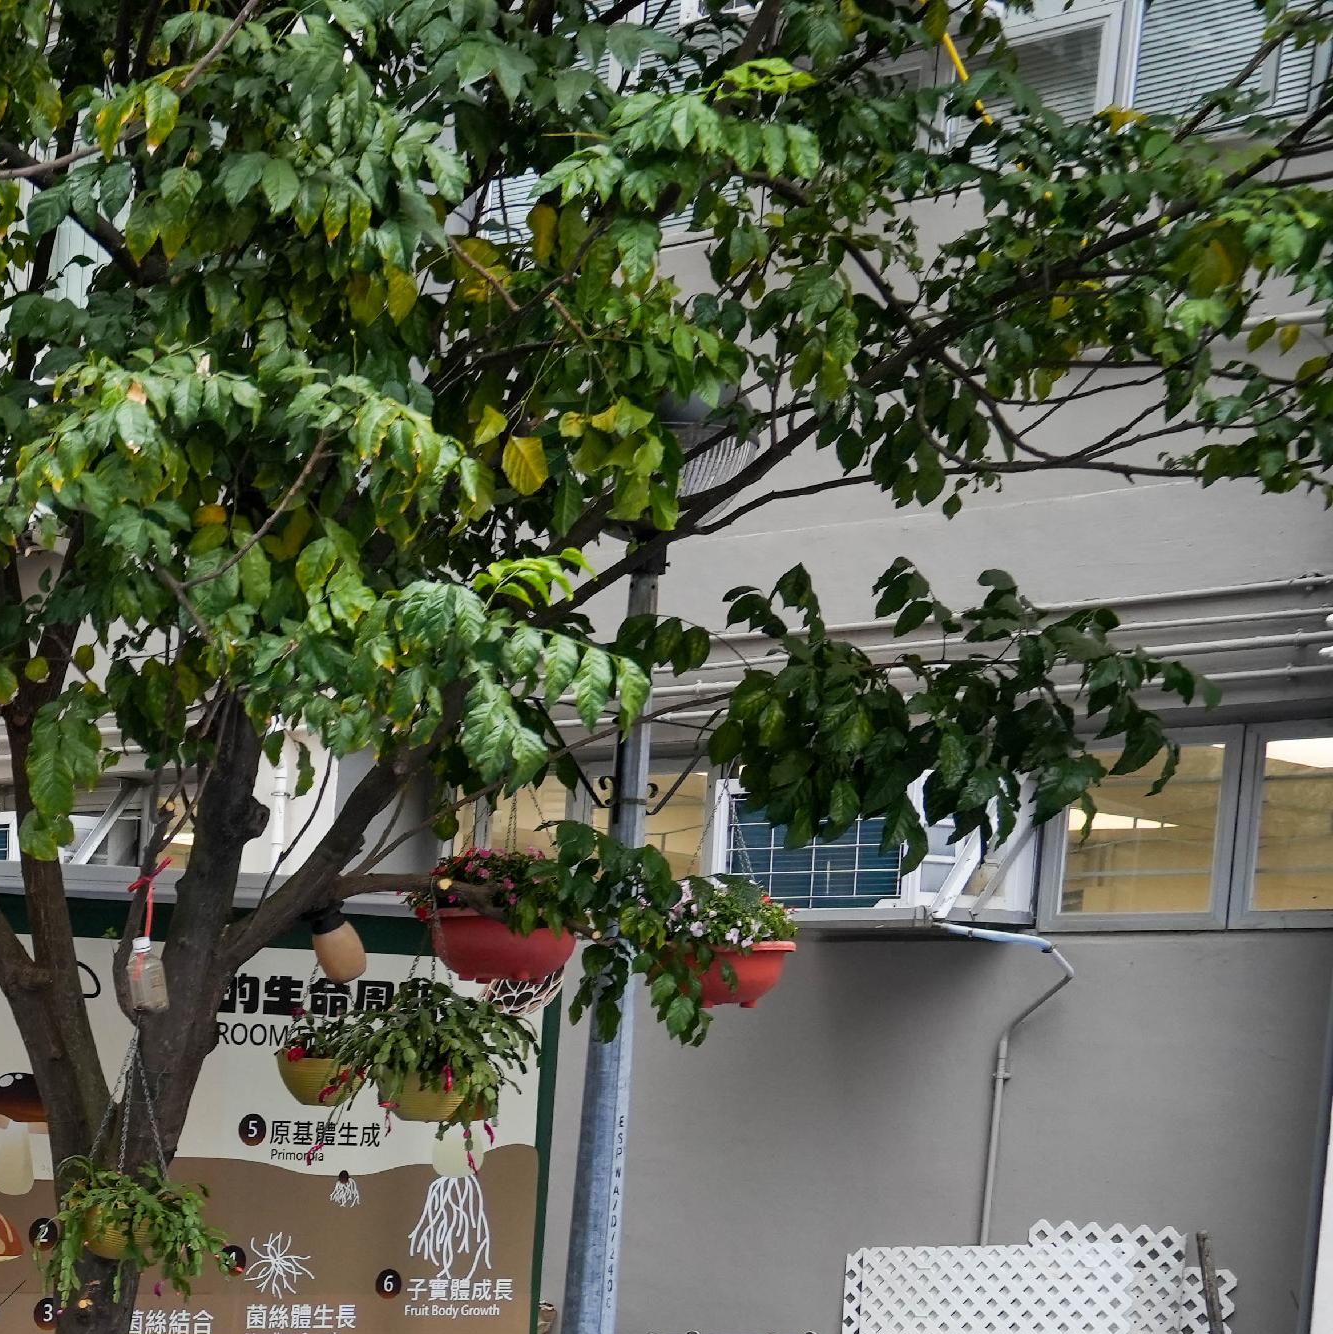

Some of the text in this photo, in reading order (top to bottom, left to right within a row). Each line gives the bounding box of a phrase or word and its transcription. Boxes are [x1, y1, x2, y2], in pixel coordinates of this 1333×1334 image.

[217, 972, 431, 1018] 的生命周
[218, 1022, 290, 1048] ROOM
[247, 1119, 381, 1148] 5 原基體生成
[38, 1224, 49, 1243] 2
[383, 1275, 514, 1302] 6 子實體成長
[43, 1303, 53, 1322] 3
[245, 1303, 357, 1330] 菌絲體生長
[404, 1304, 501, 1319] Fruit Body Growth
